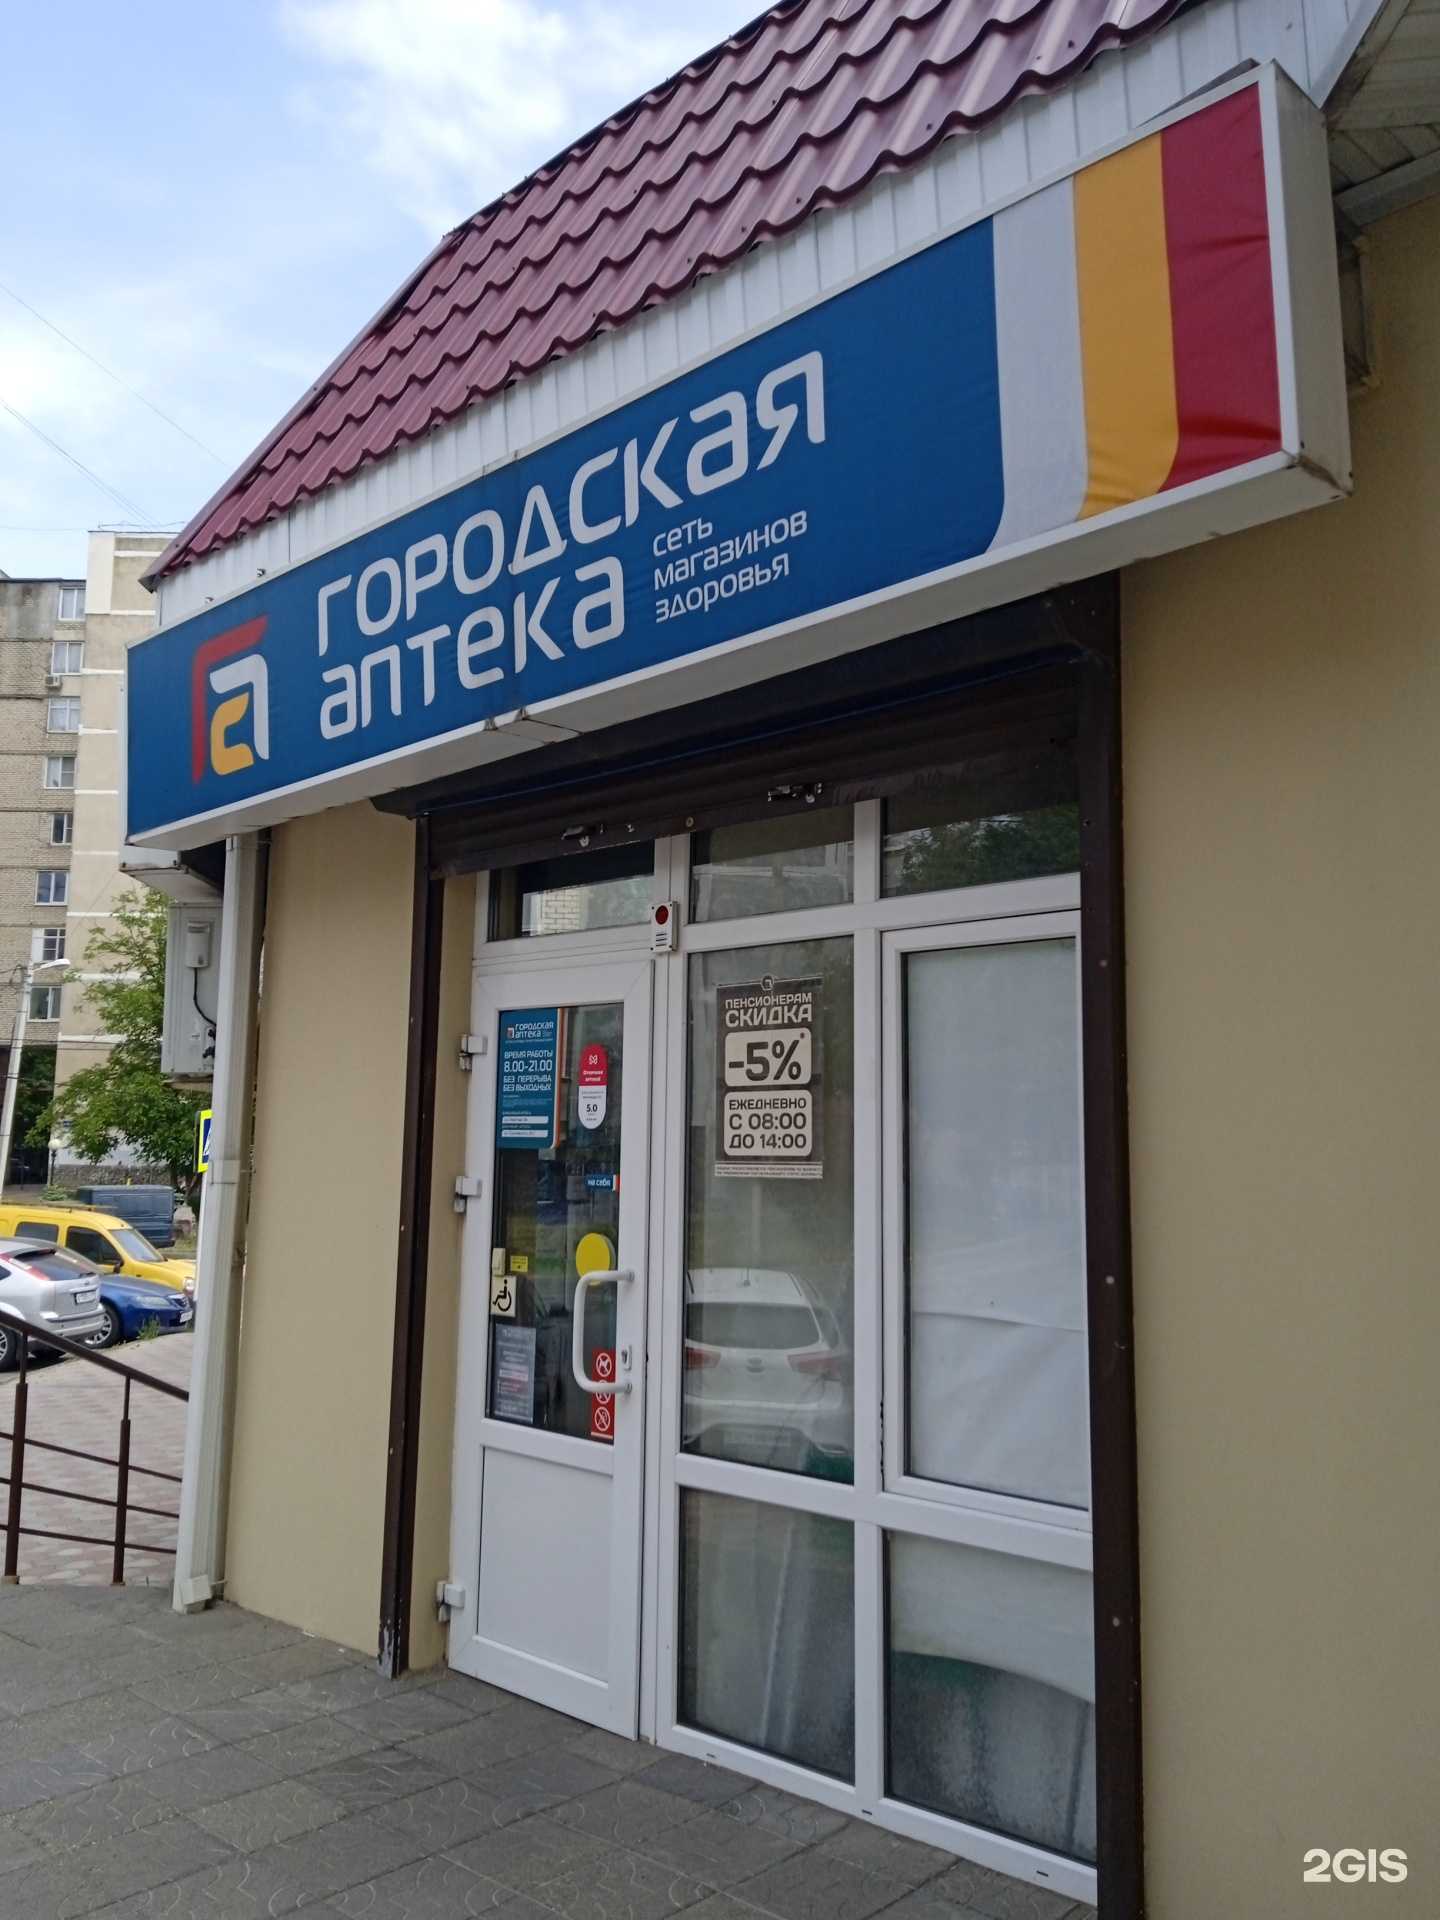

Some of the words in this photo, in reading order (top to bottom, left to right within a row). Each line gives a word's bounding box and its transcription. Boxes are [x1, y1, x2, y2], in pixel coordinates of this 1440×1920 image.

[318, 351, 825, 656] ГОРОДСКАЯ
[653, 518, 713, 557] сеть
[654, 510, 808, 591] магазинов
[655, 553, 790, 624] здоровья
[320, 556, 625, 740] аптека
[725, 992, 813, 1009] ПЕНСИОНЕРАМ
[725, 1004, 813, 1028] СКИДКА
[504, 1050, 526, 1059] ВРЕМЯ
[526, 1049, 553, 1058] РАБОТЫ
[504, 1059, 553, 1072] 8.00-21.00
[503, 1075, 515, 1083] БЕЗ
[517, 1074, 552, 1083] ПЕРЕРЫВА
[503, 1083, 515, 1091] БЕЗ
[728, 1098, 807, 1111] ЕЖЕДНЕВНО
[729, 1113, 743, 1130] С
[748, 1112, 807, 1130] 08:00
[729, 1133, 755, 1149] ДО
[760, 1133, 807, 1149] 14:00
